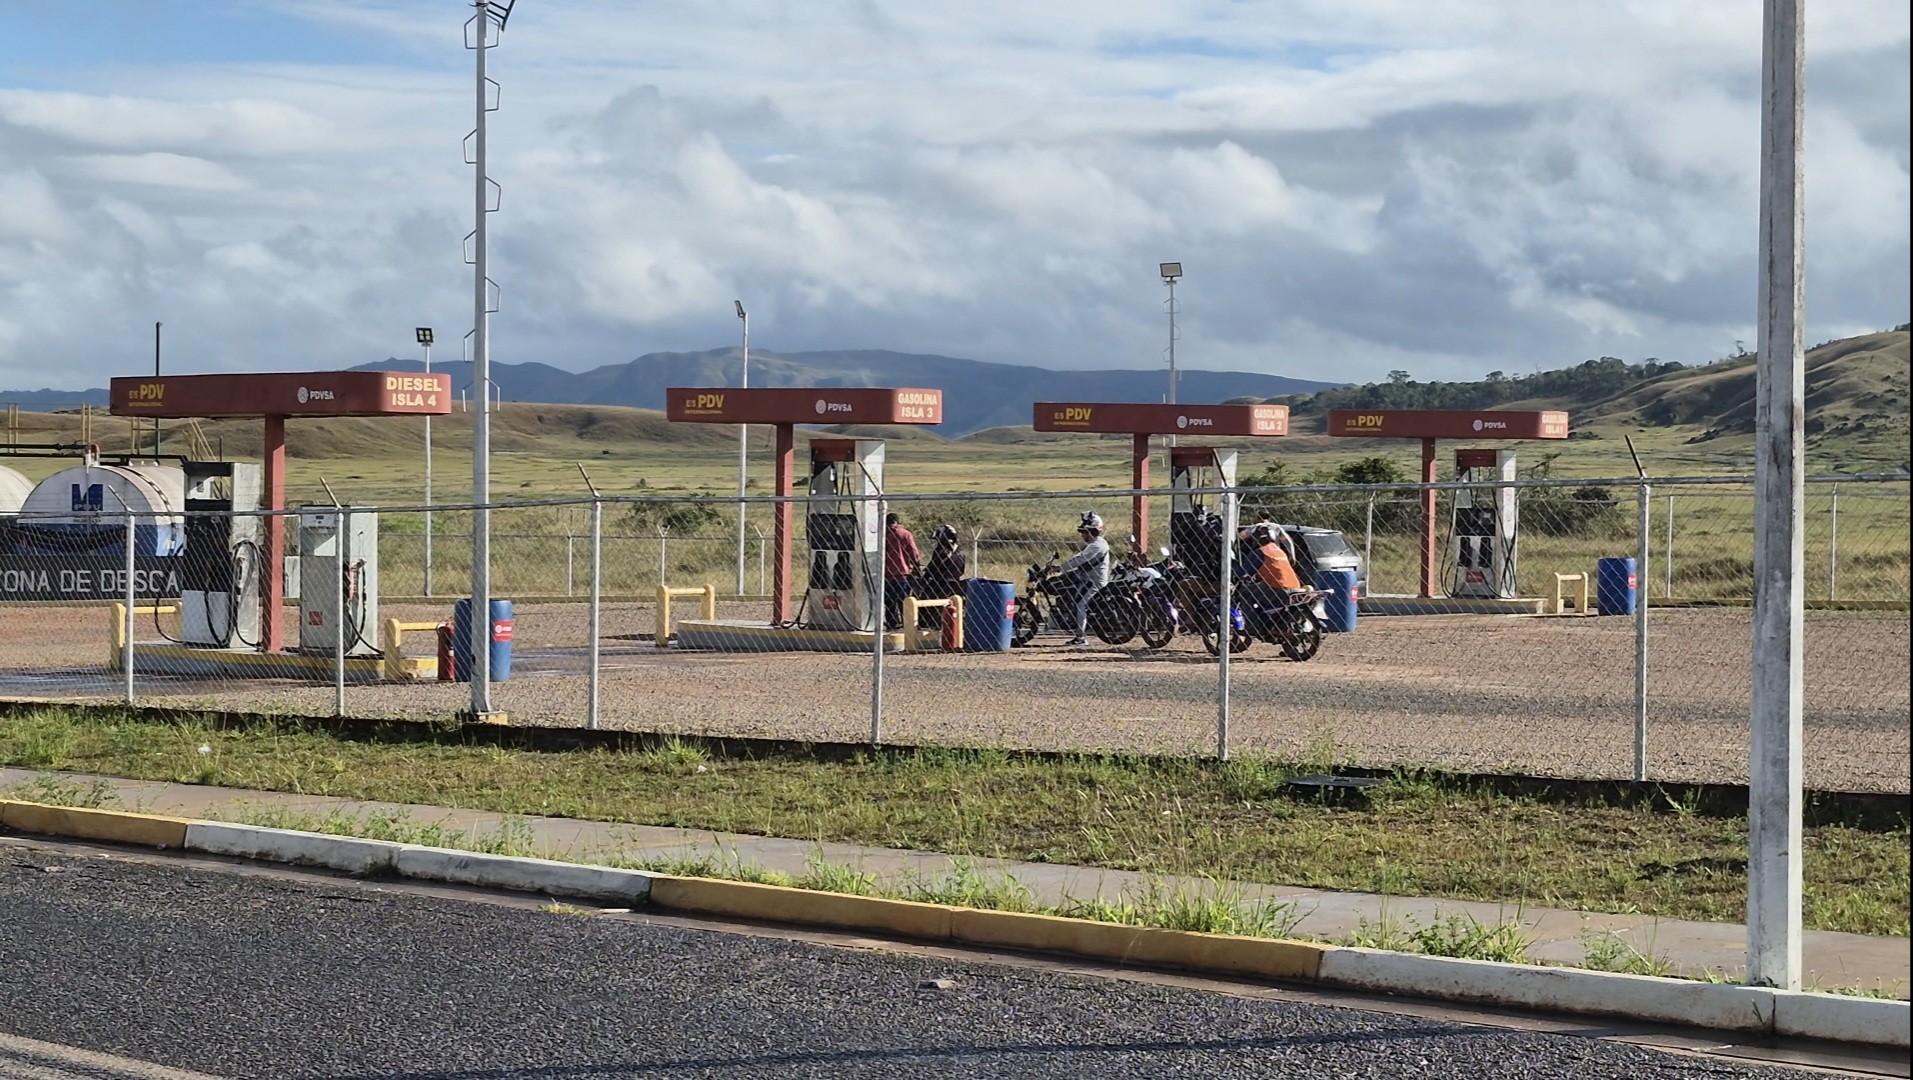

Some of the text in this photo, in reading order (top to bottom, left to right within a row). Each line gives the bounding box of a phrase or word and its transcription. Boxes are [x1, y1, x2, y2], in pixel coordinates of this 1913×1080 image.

[387, 377, 442, 391] DIESEL
[129, 384, 165, 399] ES PDV
[310, 390, 334, 400] PDVSA
[392, 393, 437, 407] ISLA 4
[698, 394, 725, 408] PDV
[898, 393, 938, 405] GASOLINA
[828, 403, 852, 412] PDVSA
[901, 406, 934, 418] ISLA 3
[1054, 407, 1092, 420] ES PDV
[1189, 418, 1213, 426] PDVSA
[1257, 420, 1282, 431] ISLA 2
[1357, 415, 1384, 427] PDV
[0, 570, 51, 592] ONA
[60, 569, 92, 592] DE
